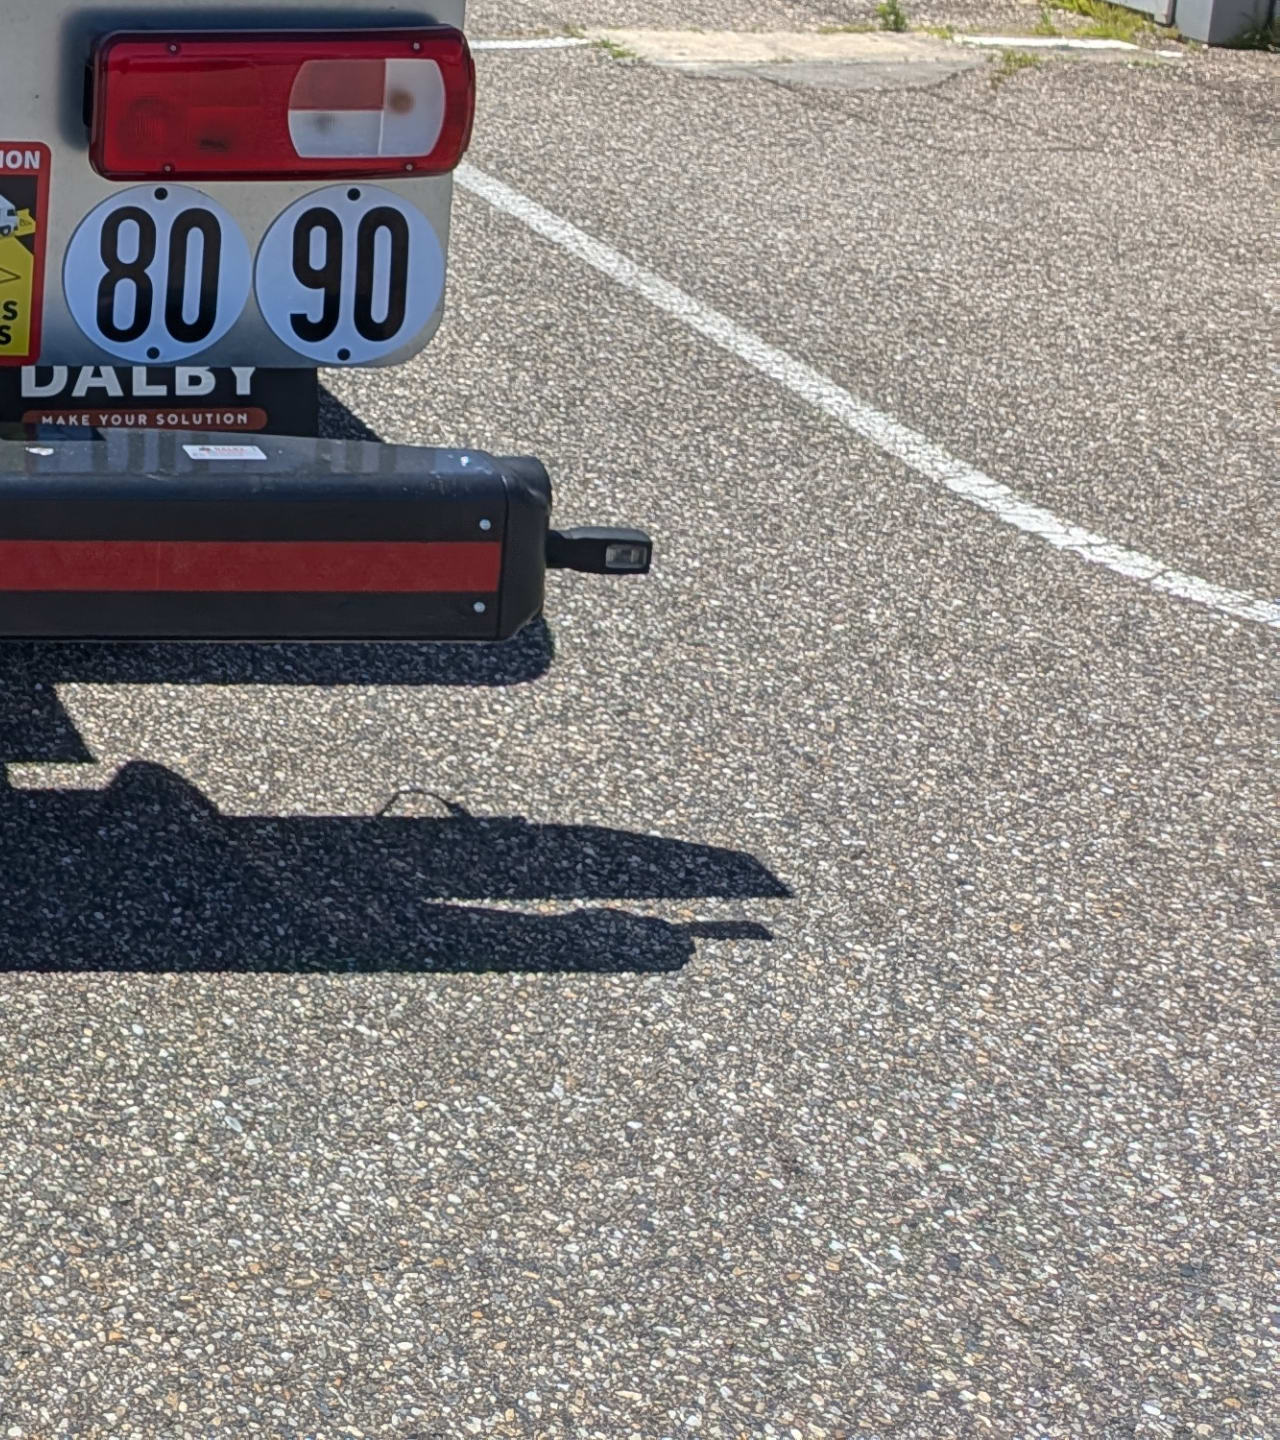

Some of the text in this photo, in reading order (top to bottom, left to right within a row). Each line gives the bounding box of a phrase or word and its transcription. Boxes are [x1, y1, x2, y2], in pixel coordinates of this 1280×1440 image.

[95, 205, 223, 344] 80
[289, 205, 410, 343] 90
[20, 365, 257, 398] DALBY
[41, 412, 249, 427] MAKE YOUR SOLUTION
